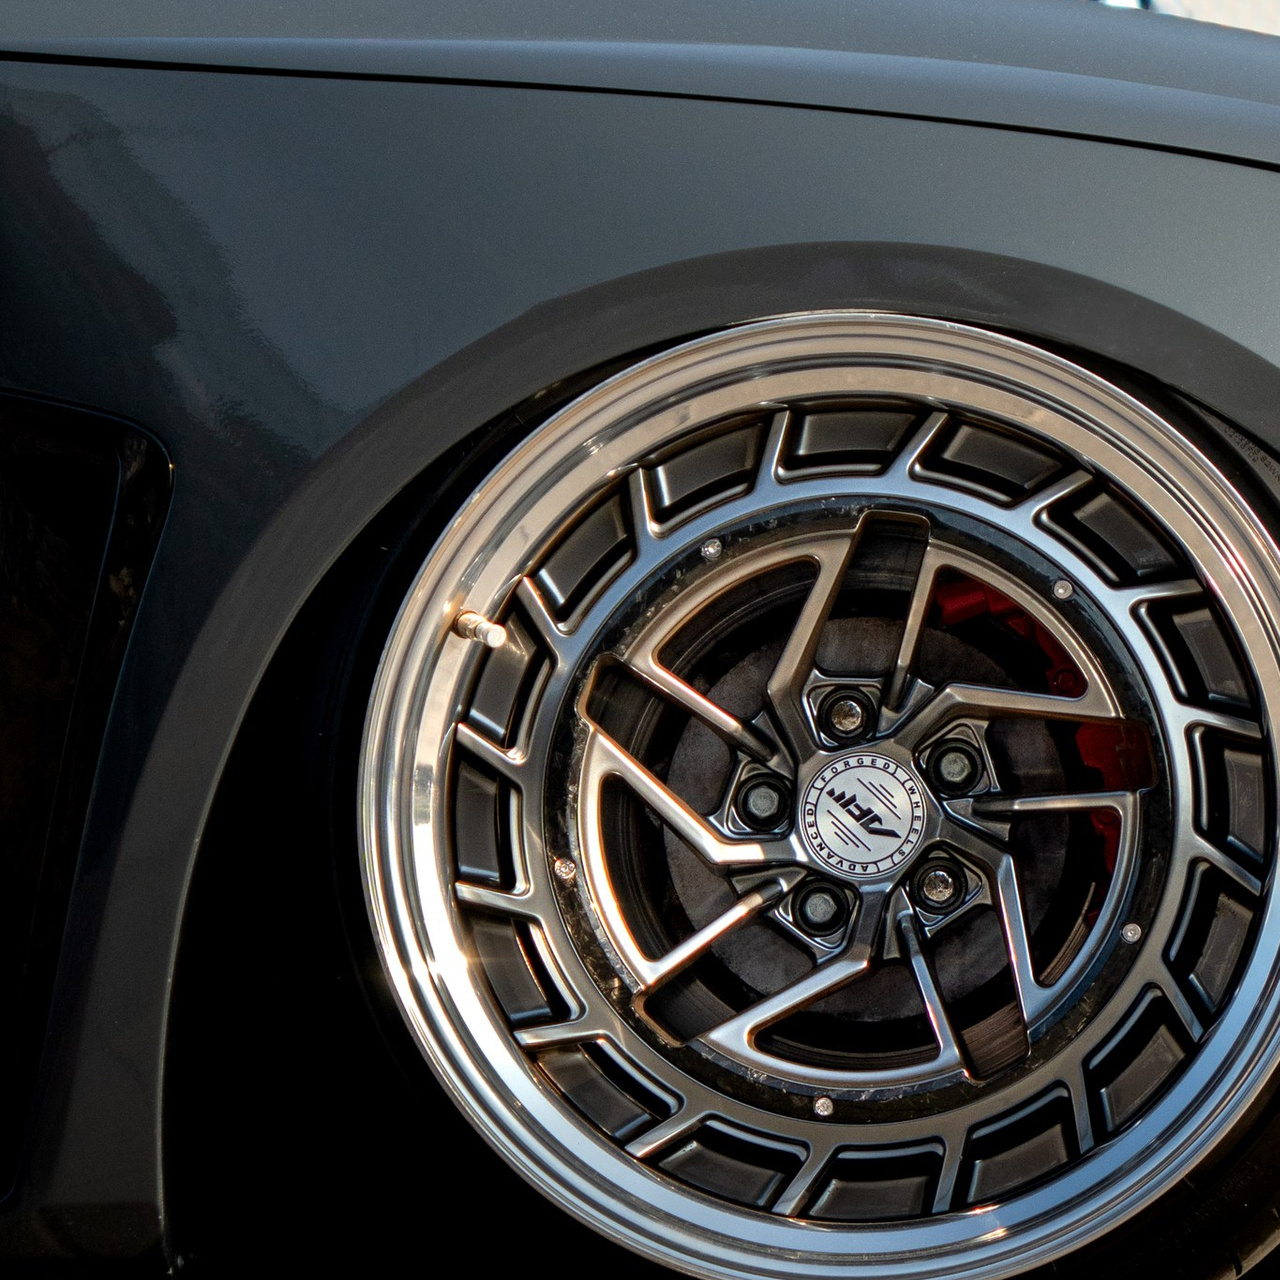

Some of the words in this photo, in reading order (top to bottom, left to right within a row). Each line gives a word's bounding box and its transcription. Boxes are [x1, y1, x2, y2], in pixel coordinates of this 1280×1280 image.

[820, 757, 891, 783] FORGED
[806, 808, 869, 872] ADVANCED
[898, 785, 922, 857] WHEELS
